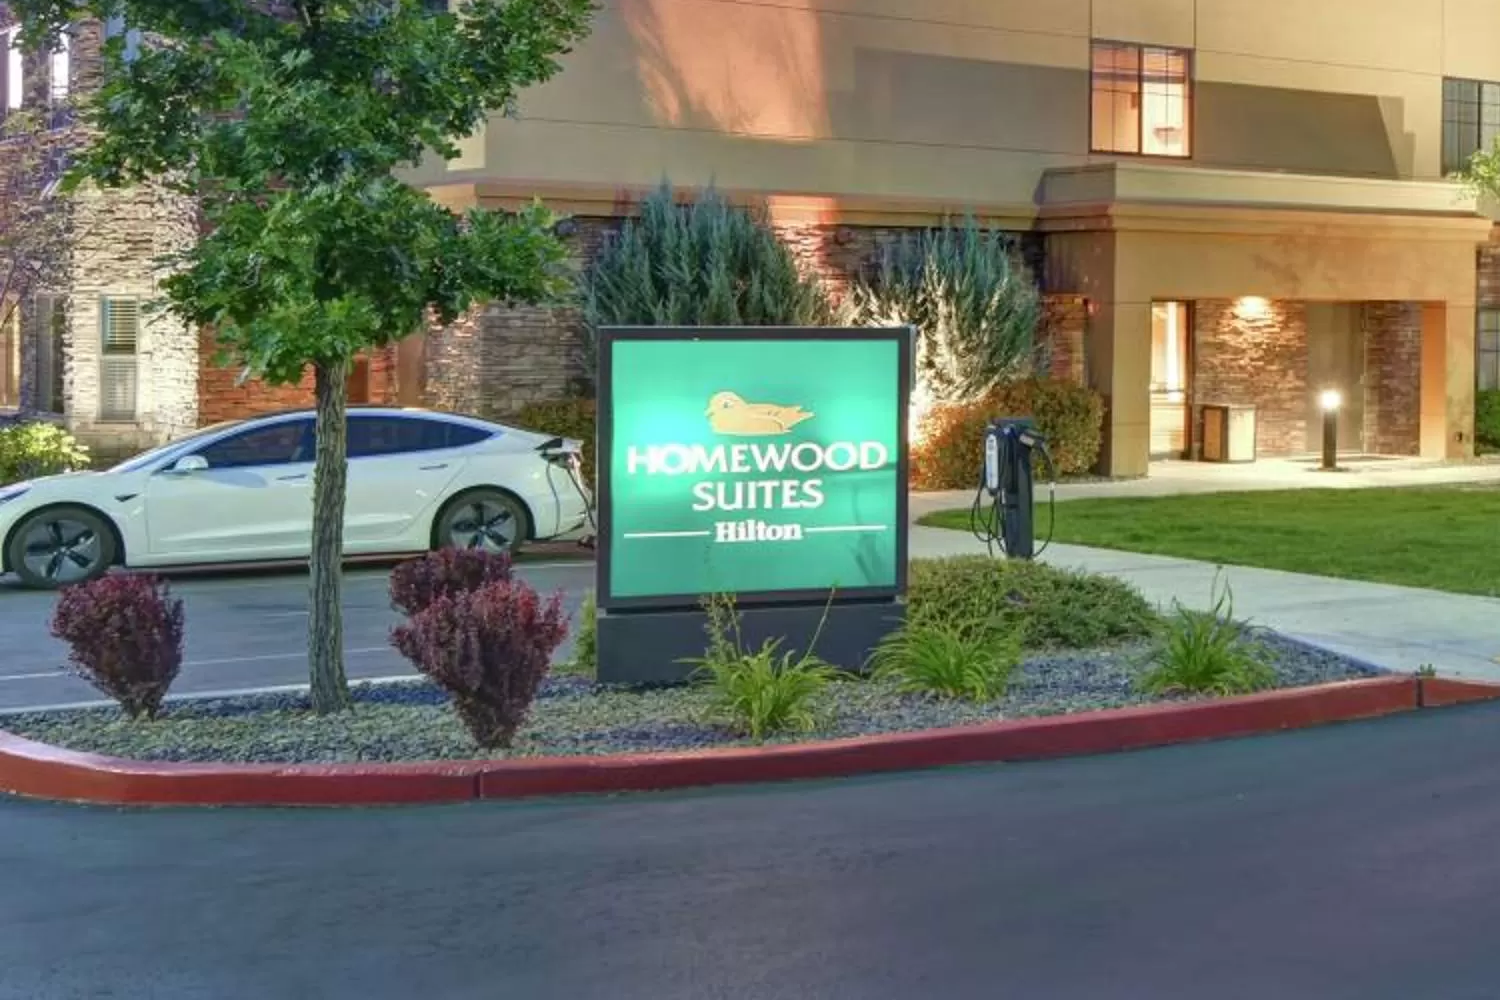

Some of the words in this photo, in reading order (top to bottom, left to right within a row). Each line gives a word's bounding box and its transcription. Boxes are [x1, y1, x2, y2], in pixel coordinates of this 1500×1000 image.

[626, 440, 888, 475] HOMEWOOD
[692, 478, 825, 511] SUITES
[714, 519, 804, 543] Hilton
